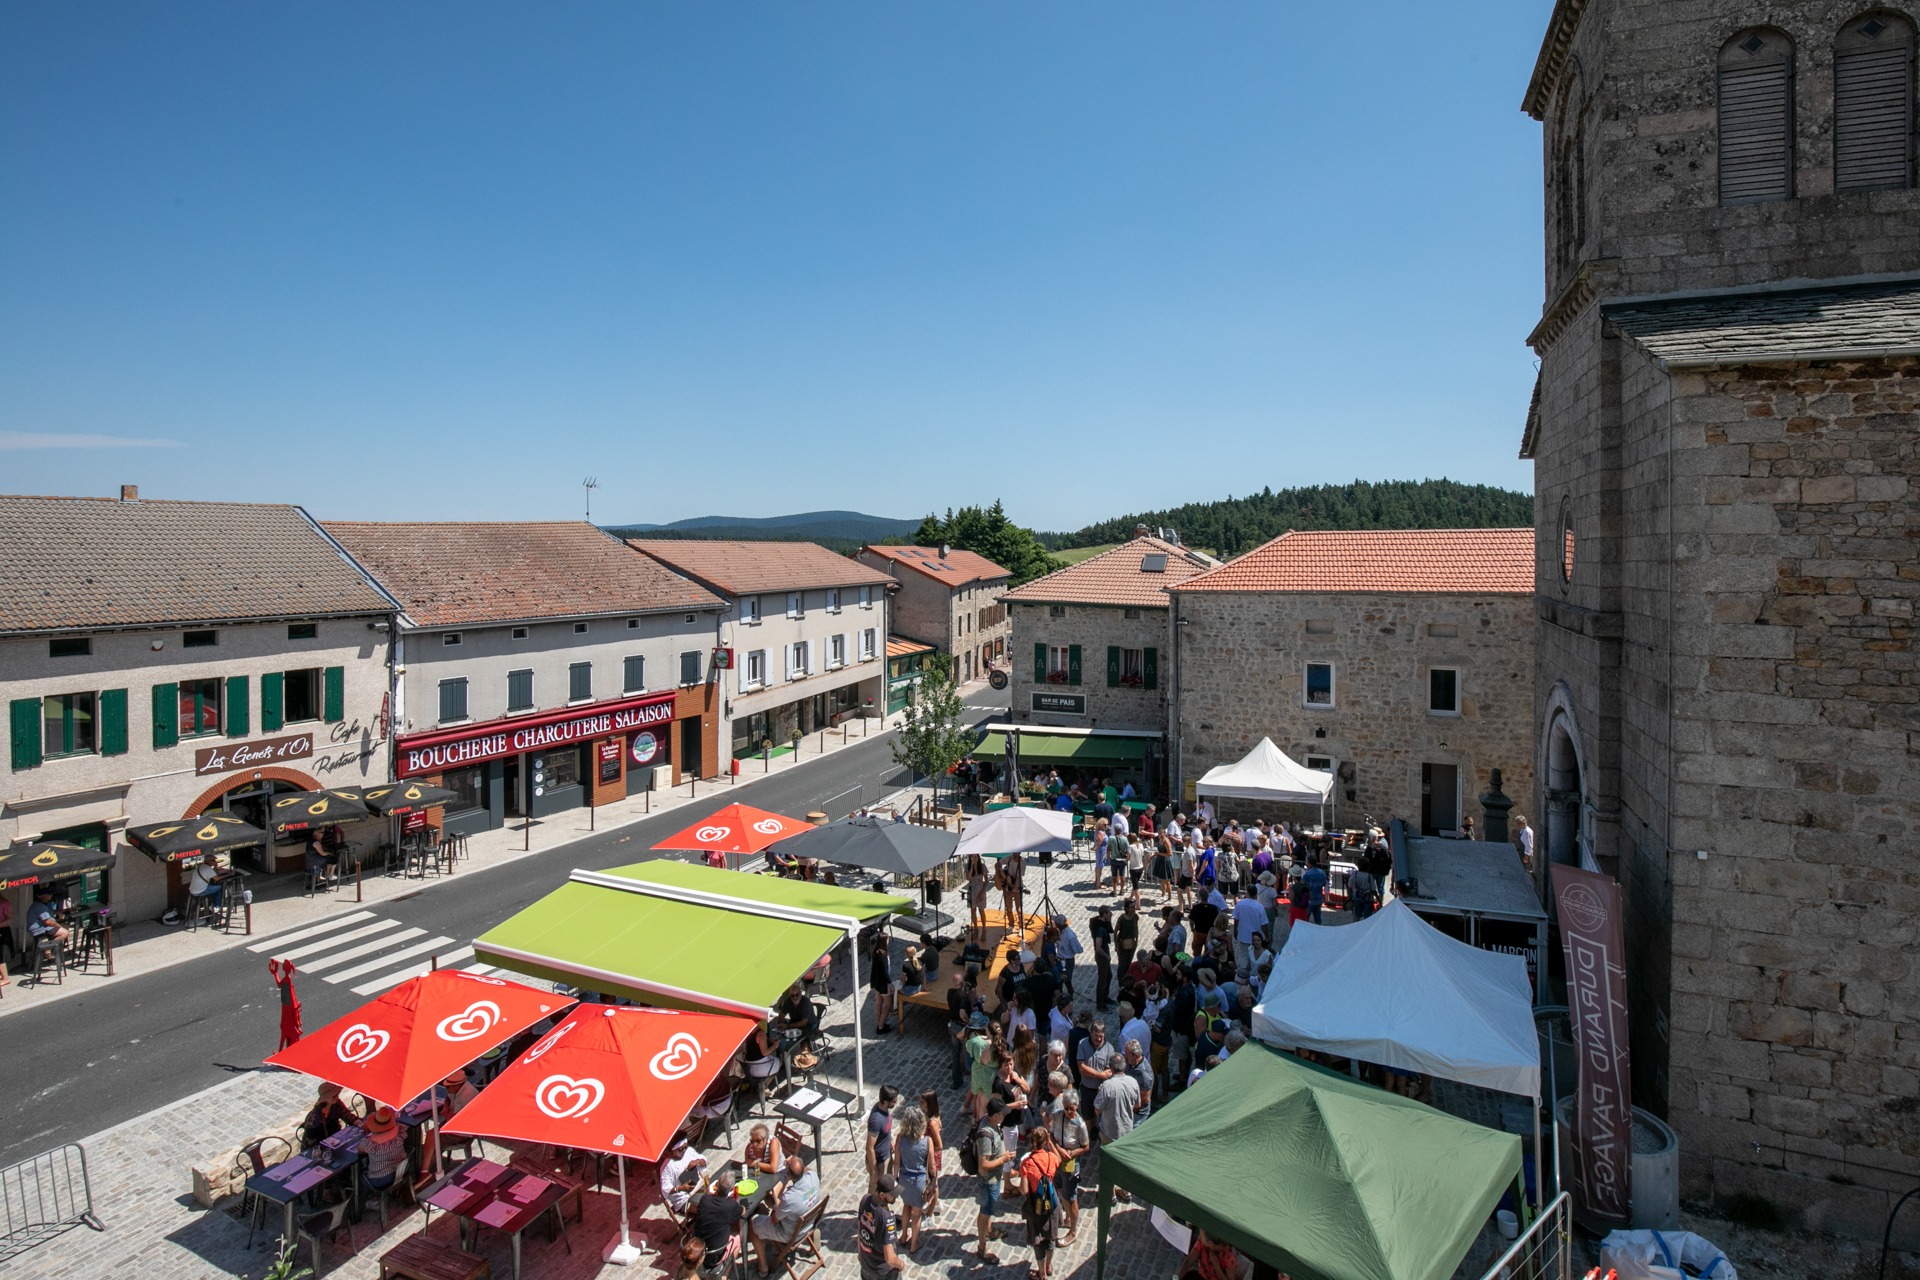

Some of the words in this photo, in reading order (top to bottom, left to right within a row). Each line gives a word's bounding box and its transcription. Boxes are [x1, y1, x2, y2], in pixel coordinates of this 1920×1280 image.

[381, 693, 389, 738] TABAC
[408, 733, 508, 771] BOUCHERIE
[513, 714, 612, 750] CHARCUTERIE
[615, 702, 673, 729] SALAISON
[199, 749, 228, 772] Les
[175, 849, 201, 860] METEOR
[7, 876, 39, 888] METEOR
